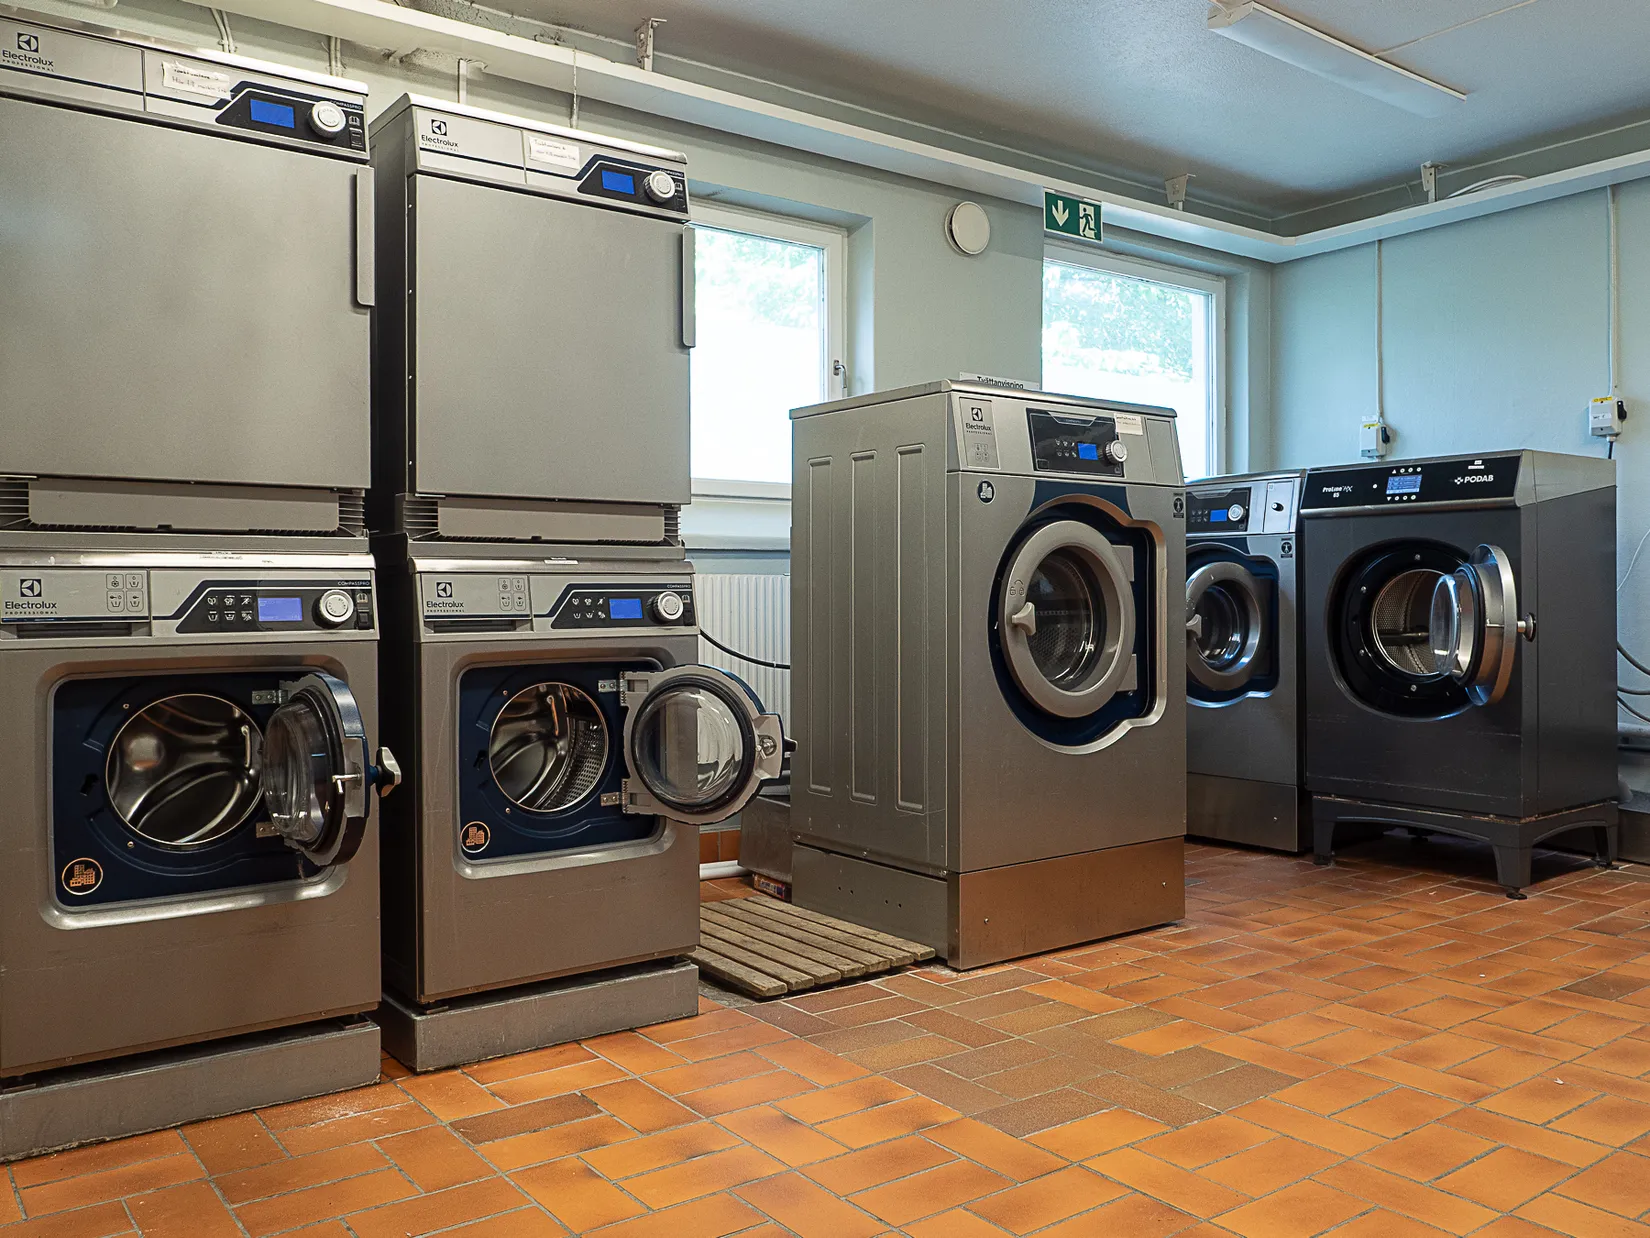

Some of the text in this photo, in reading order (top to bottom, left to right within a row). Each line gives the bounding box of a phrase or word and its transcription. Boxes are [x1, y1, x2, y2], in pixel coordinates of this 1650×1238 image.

[2, 49, 54, 67] Electrolux
[421, 134, 459, 147] Electrolux
[965, 422, 992, 431] Electrolux
[1463, 474, 1494, 484] PODAB
[4, 600, 58, 610] Electrolux
[426, 600, 464, 608] Electrolux
